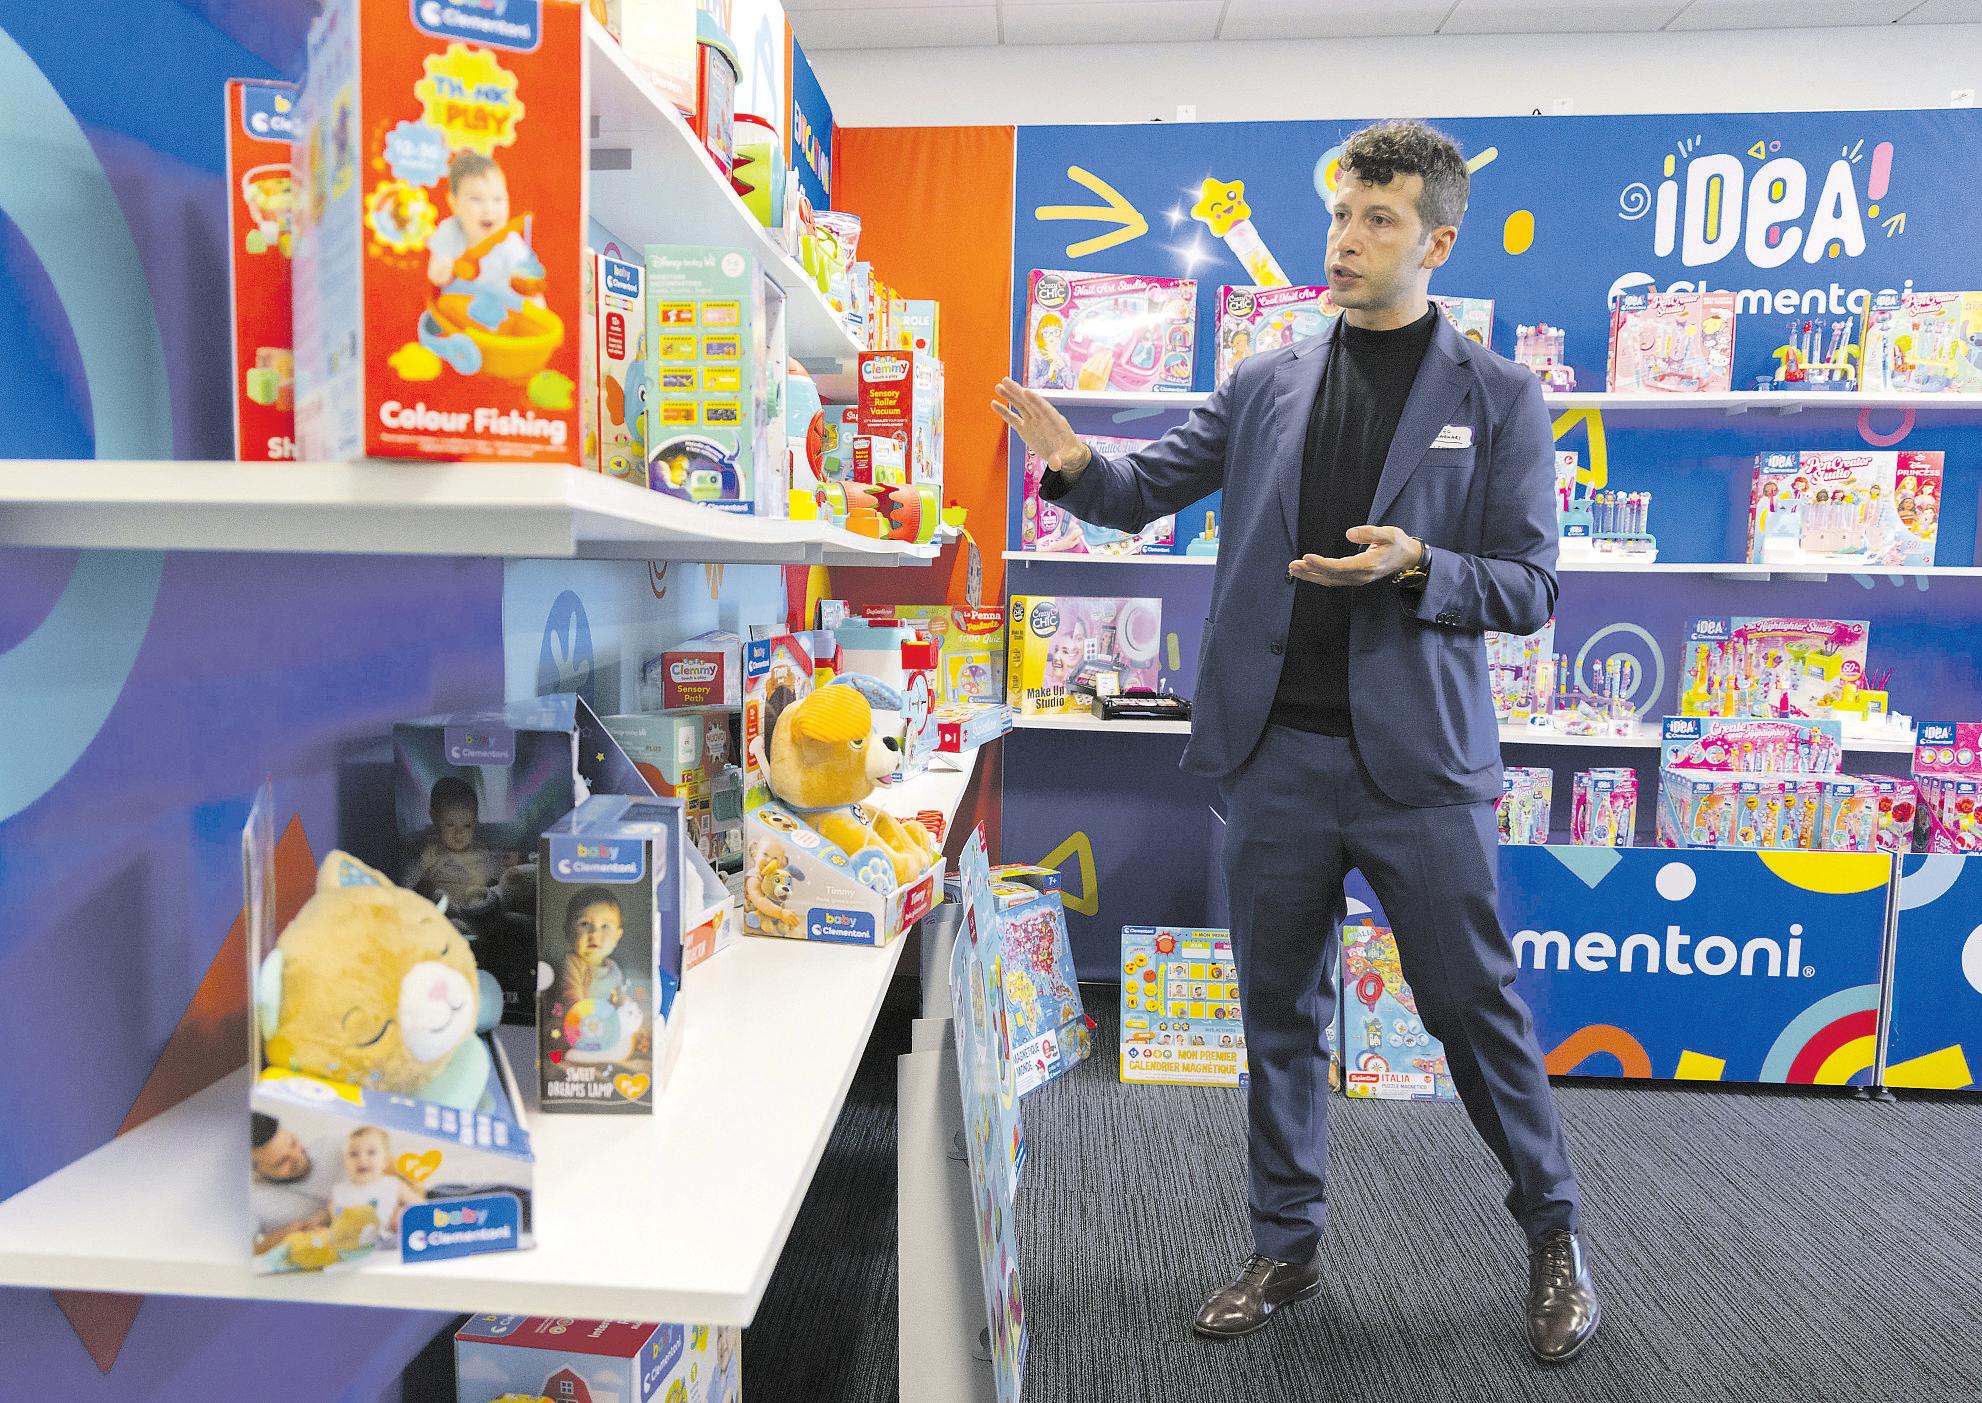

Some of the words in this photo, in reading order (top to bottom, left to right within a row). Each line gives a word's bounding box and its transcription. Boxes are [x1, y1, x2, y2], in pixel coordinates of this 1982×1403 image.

[1039, 287, 1065, 299] CHIC
[1074, 284, 1096, 296] Nail
[1098, 284, 1116, 295] Art
[1117, 279, 1148, 291] Studio
[1229, 300, 1252, 310] CHIC
[863, 362, 908, 376] Clemmy
[869, 388, 900, 400] Sensory
[874, 398, 897, 407] Roller
[870, 407, 901, 416] Vacuum
[379, 400, 470, 432] Colour
[474, 407, 567, 445] Fishing
[1806, 457, 1831, 474] Pen
[1832, 457, 1872, 470] Creator
[1812, 468, 1853, 485] Studio
[971, 609, 1001, 620] Penna
[1032, 615, 1059, 627] CHIC
[1758, 621, 1807, 633] Highlighter
[1807, 623, 1836, 635] Studio
[671, 664, 716, 677] Clemmy
[677, 684, 711, 695] Sensory
[1027, 686, 1051, 699] Make
[1053, 684, 1065, 697] Up
[684, 694, 704, 703] Path
[1035, 697, 1065, 710] Studio
[1710, 722, 1746, 736] Create
[576, 842, 618, 861] baby
[572, 860, 637, 873] Clementoni
[1048, 876, 1058, 885] 7+
[825, 886, 856, 897] Timmy
[825, 912, 857, 927] baby
[822, 925, 870, 939] Clementoni
[1178, 1049, 1197, 1060] MON
[1199, 1050, 1237, 1063] PREMIER
[565, 1066, 596, 1082] SWEET
[1129, 1060, 1180, 1073] CALENDRIER
[1181, 1061, 1237, 1075] MAGNÉTIQUE
[1381, 1074, 1410, 1083] ITALIA
[547, 1081, 586, 1098] DREAMS
[587, 1083, 614, 1099] LAMP
[433, 1207, 488, 1228] baby
[428, 1226, 511, 1246] Clementoni
